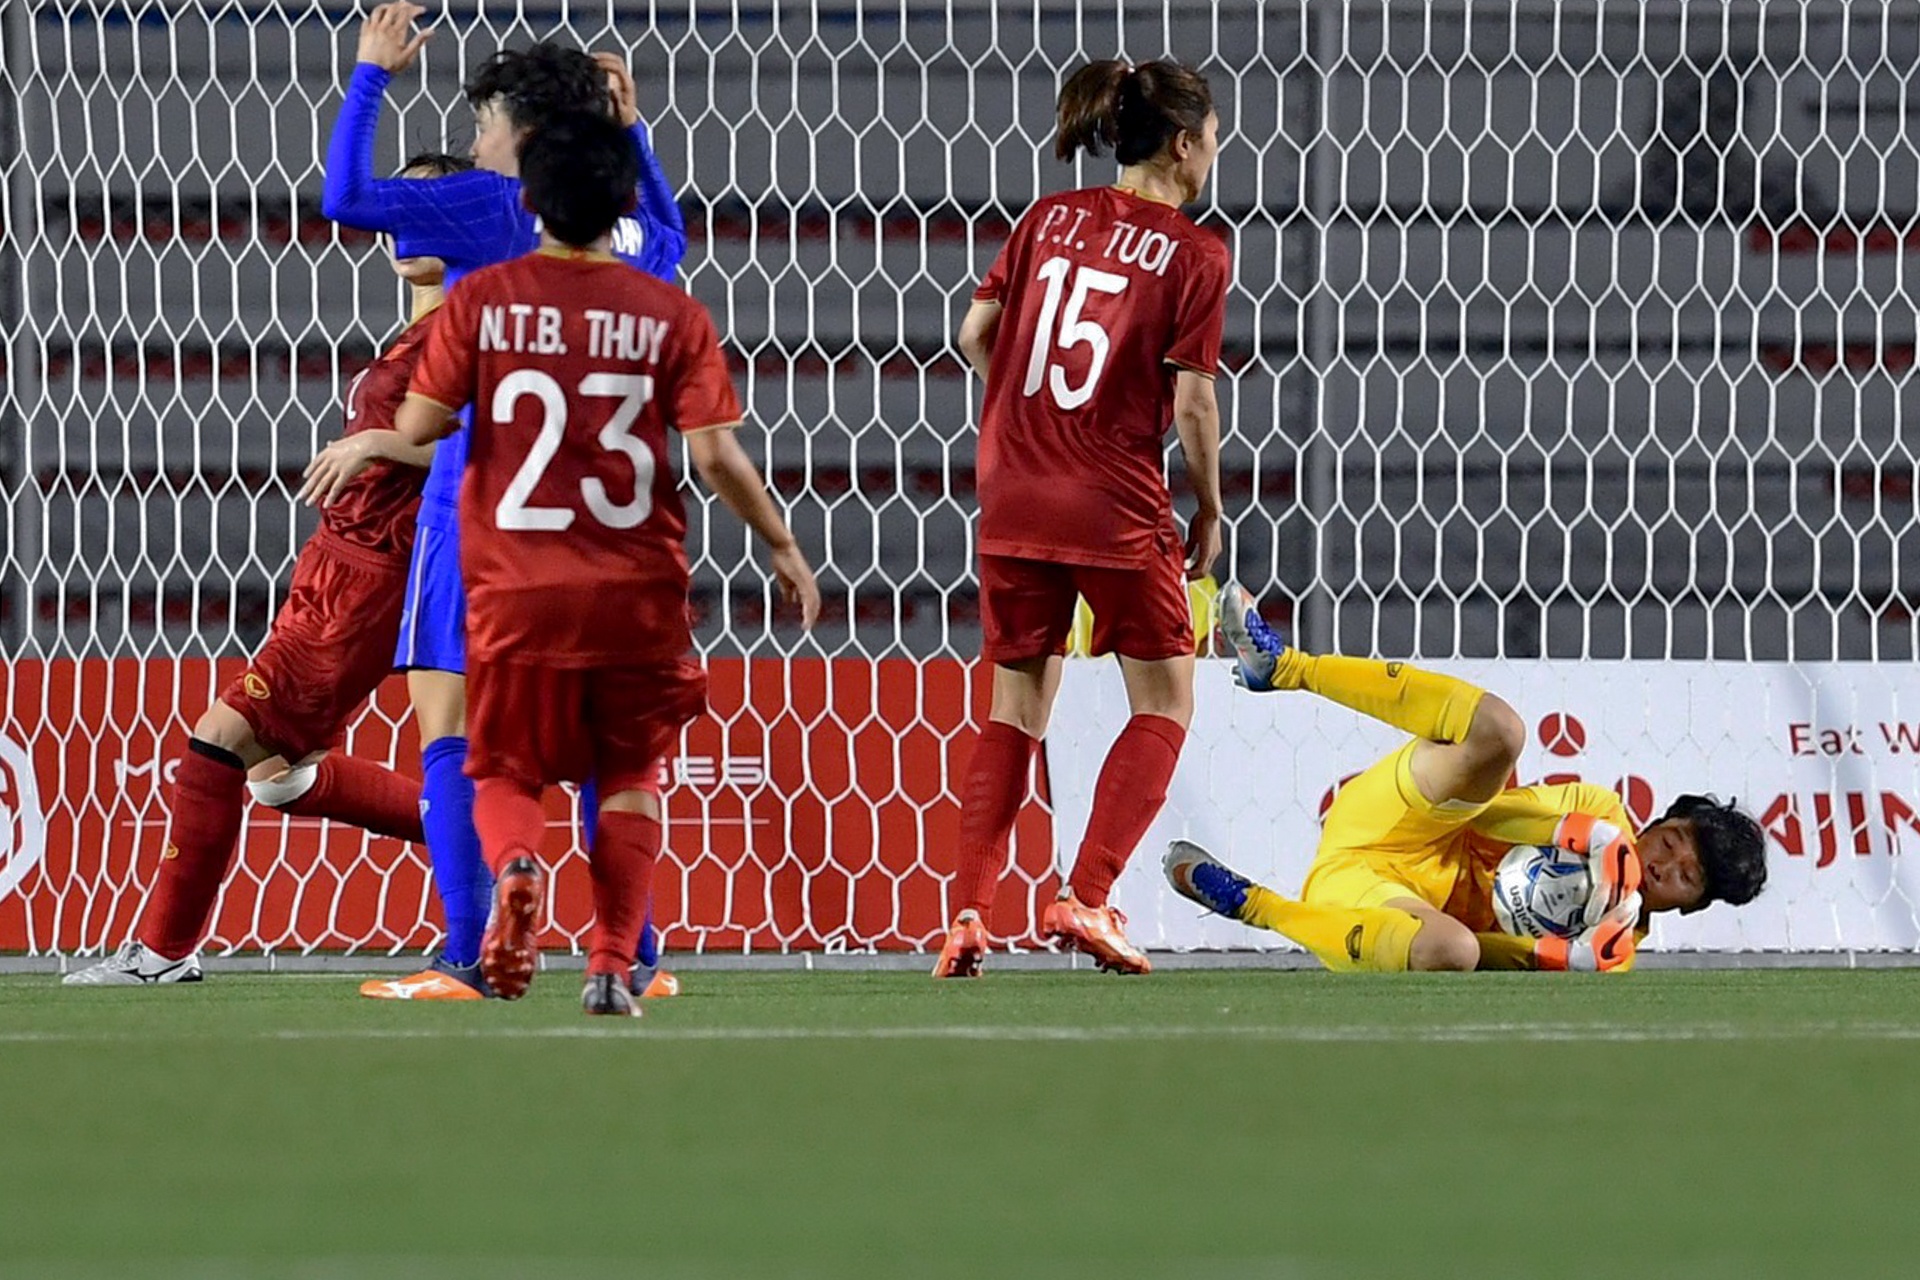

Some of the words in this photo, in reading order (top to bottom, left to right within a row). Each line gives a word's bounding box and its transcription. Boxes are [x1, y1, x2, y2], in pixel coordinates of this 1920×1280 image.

[1037, 204, 1092, 250] P.T.
[1103, 219, 1179, 276] TUOI
[479, 305, 567, 354] N.T.B.
[584, 309, 669, 364] THUY
[1023, 256, 1129, 410] 15
[491, 369, 655, 530] 23
[1789, 722, 1864, 755] Eat
